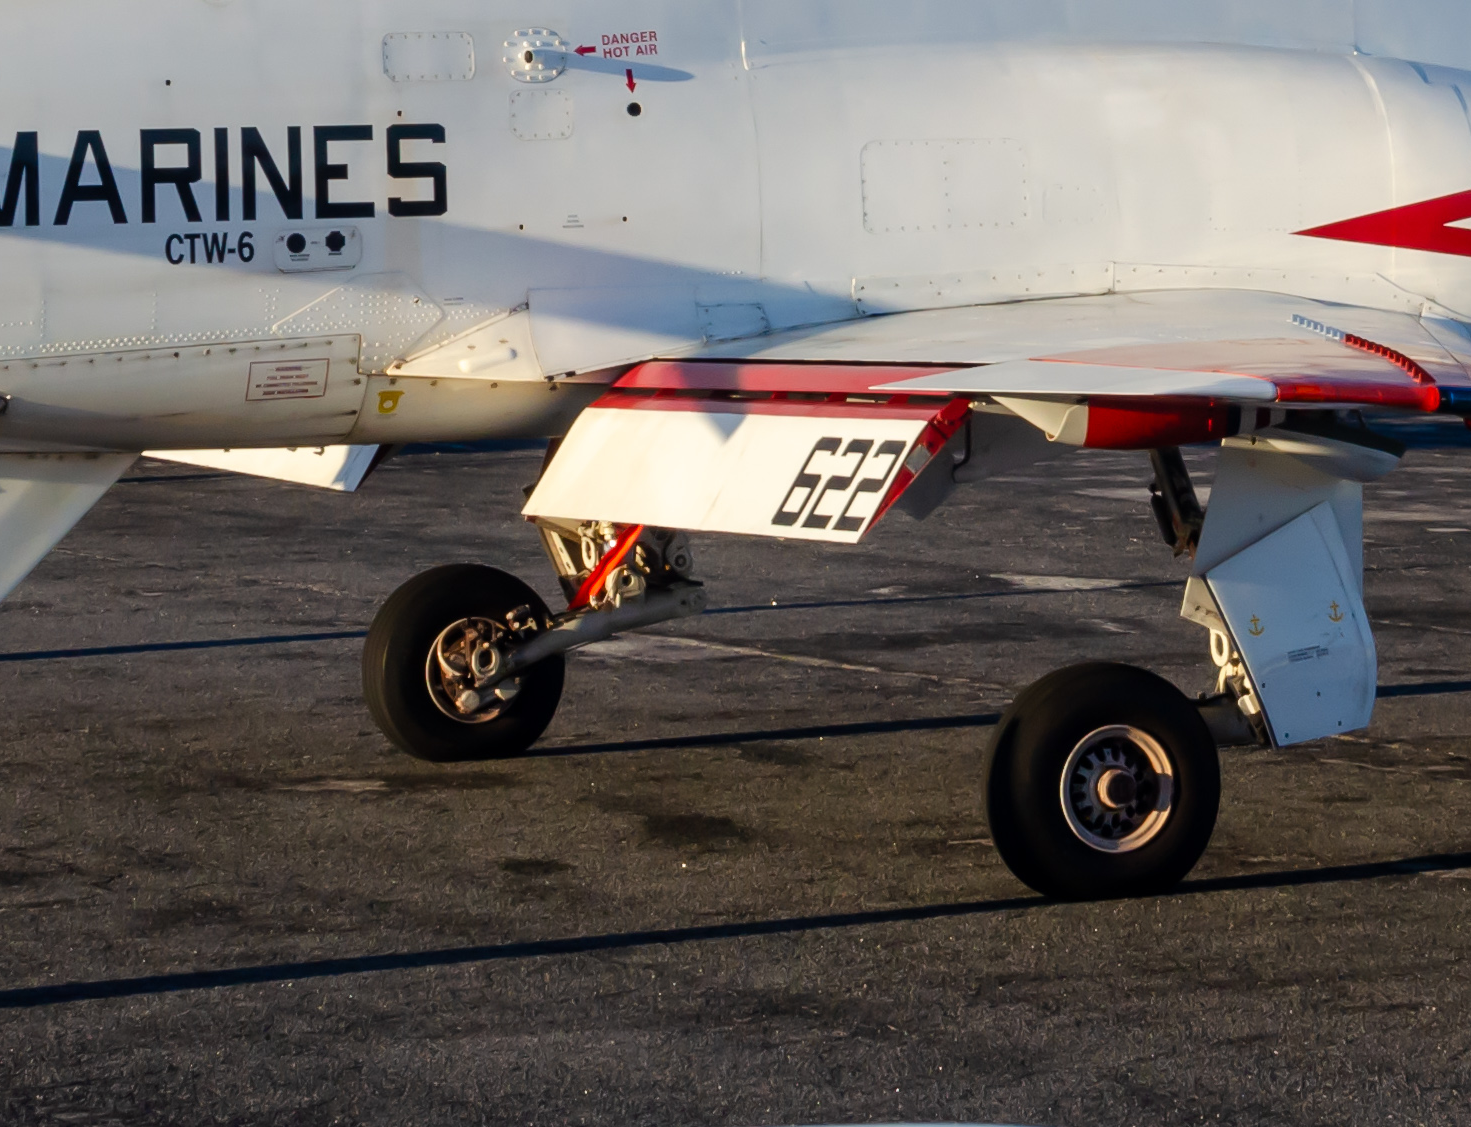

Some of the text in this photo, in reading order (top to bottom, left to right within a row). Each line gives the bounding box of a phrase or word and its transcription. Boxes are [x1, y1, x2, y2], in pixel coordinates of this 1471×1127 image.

[602, 31, 658, 46] DANGER
[603, 44, 658, 59] HOT AIR
[165, 231, 255, 265] CTW-6
[771, 436, 907, 532] 622
